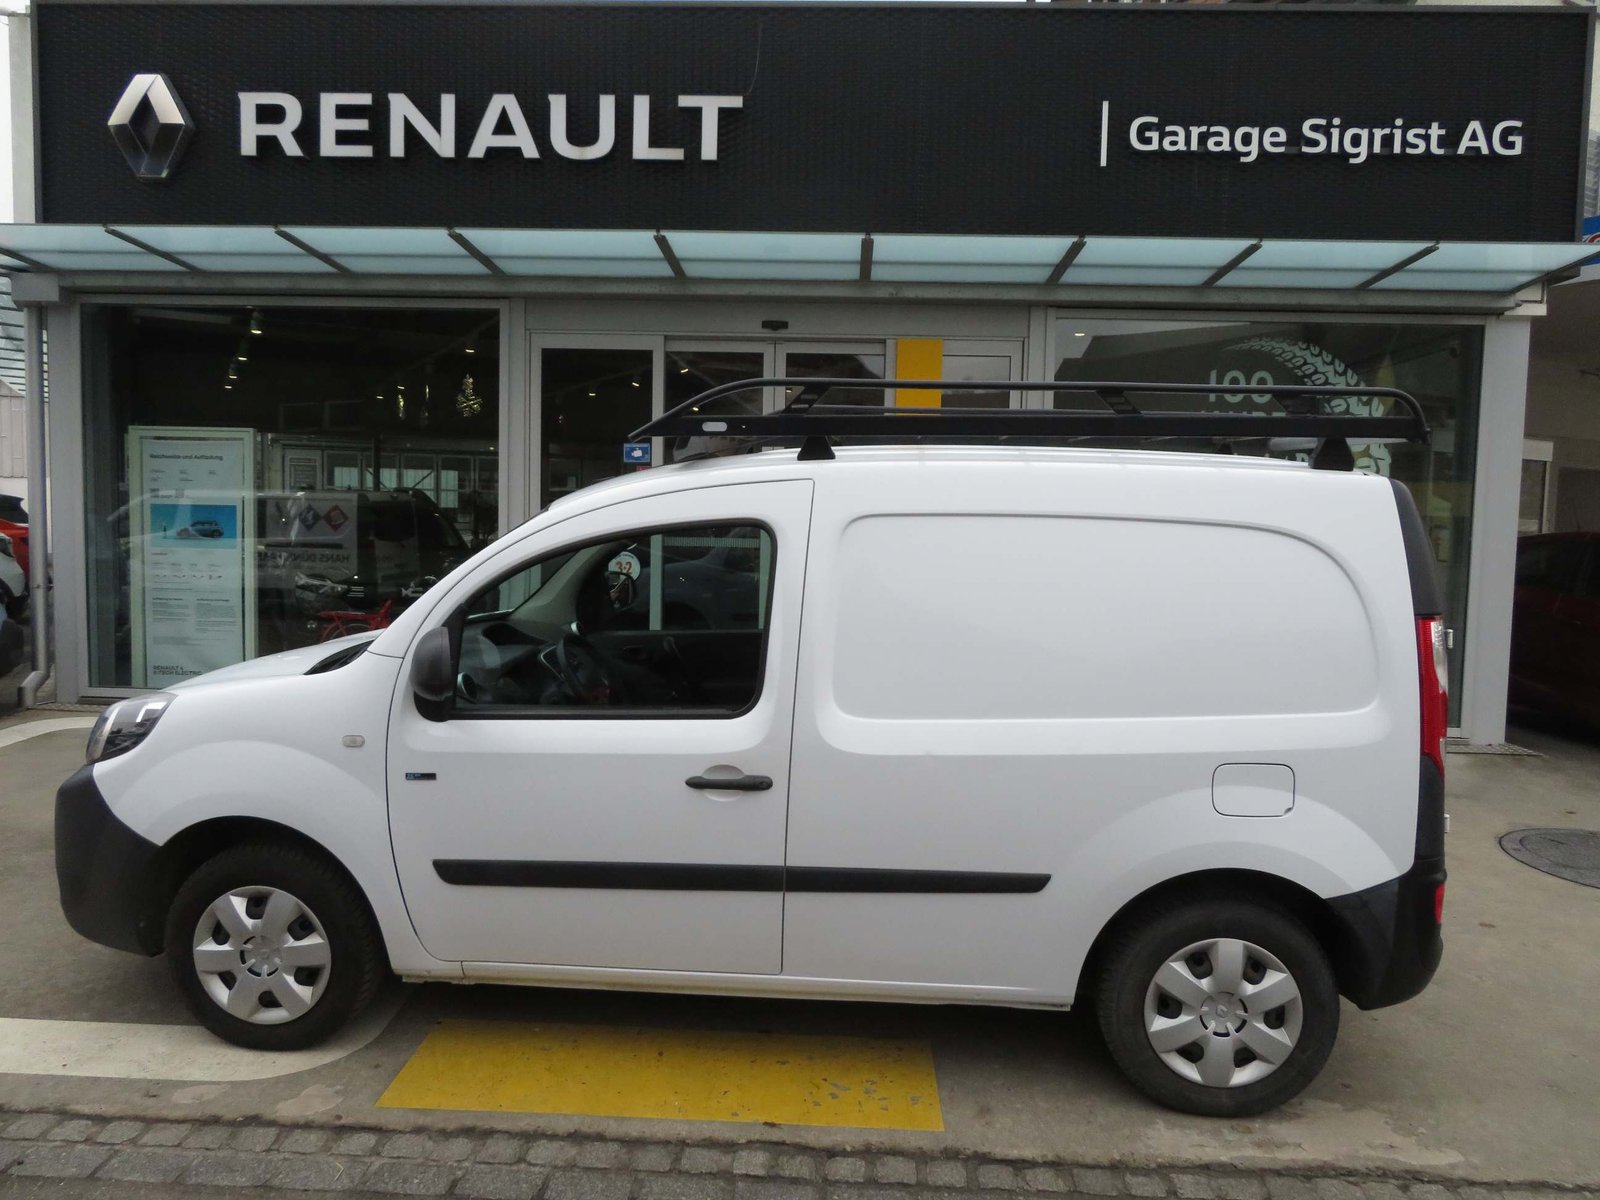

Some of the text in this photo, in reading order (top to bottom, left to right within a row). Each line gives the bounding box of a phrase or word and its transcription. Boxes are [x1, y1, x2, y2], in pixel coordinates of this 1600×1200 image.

[237, 91, 743, 162] RENAULT
[1129, 115, 1524, 164] Garage Sigrist AG
[1209, 369, 1274, 404] 100
